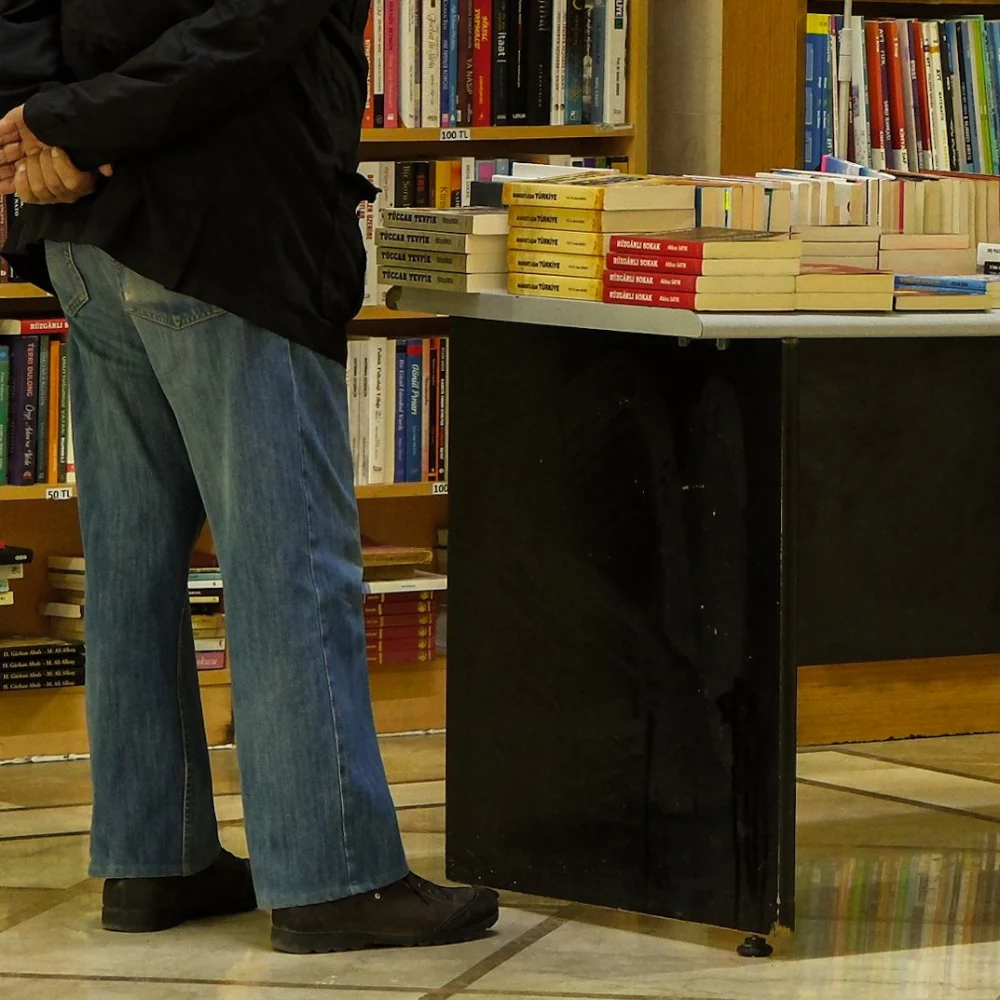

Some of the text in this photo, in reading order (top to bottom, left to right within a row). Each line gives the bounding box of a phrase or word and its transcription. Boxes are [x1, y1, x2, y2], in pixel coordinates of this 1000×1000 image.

[442, 130, 469, 139] 100 TL
[536, 191, 557, 200] TÜRKİYE
[388, 211, 437, 224] TÜCCAR TEVFİK
[537, 215, 558, 225] TÜRKİYE
[380, 230, 430, 245] TÜCCAR TEVFİK
[537, 237, 559, 246] TÜRKİYE
[381, 250, 431, 264] TÜCCAR TEVFİK
[613, 257, 639, 266] RÜZGÂRLI
[610, 273, 653, 284] RÜZGÂRLI SOKAK
[610, 291, 634, 299] RÜZGÂRLI
[48, 490, 71, 499] 50 TL
